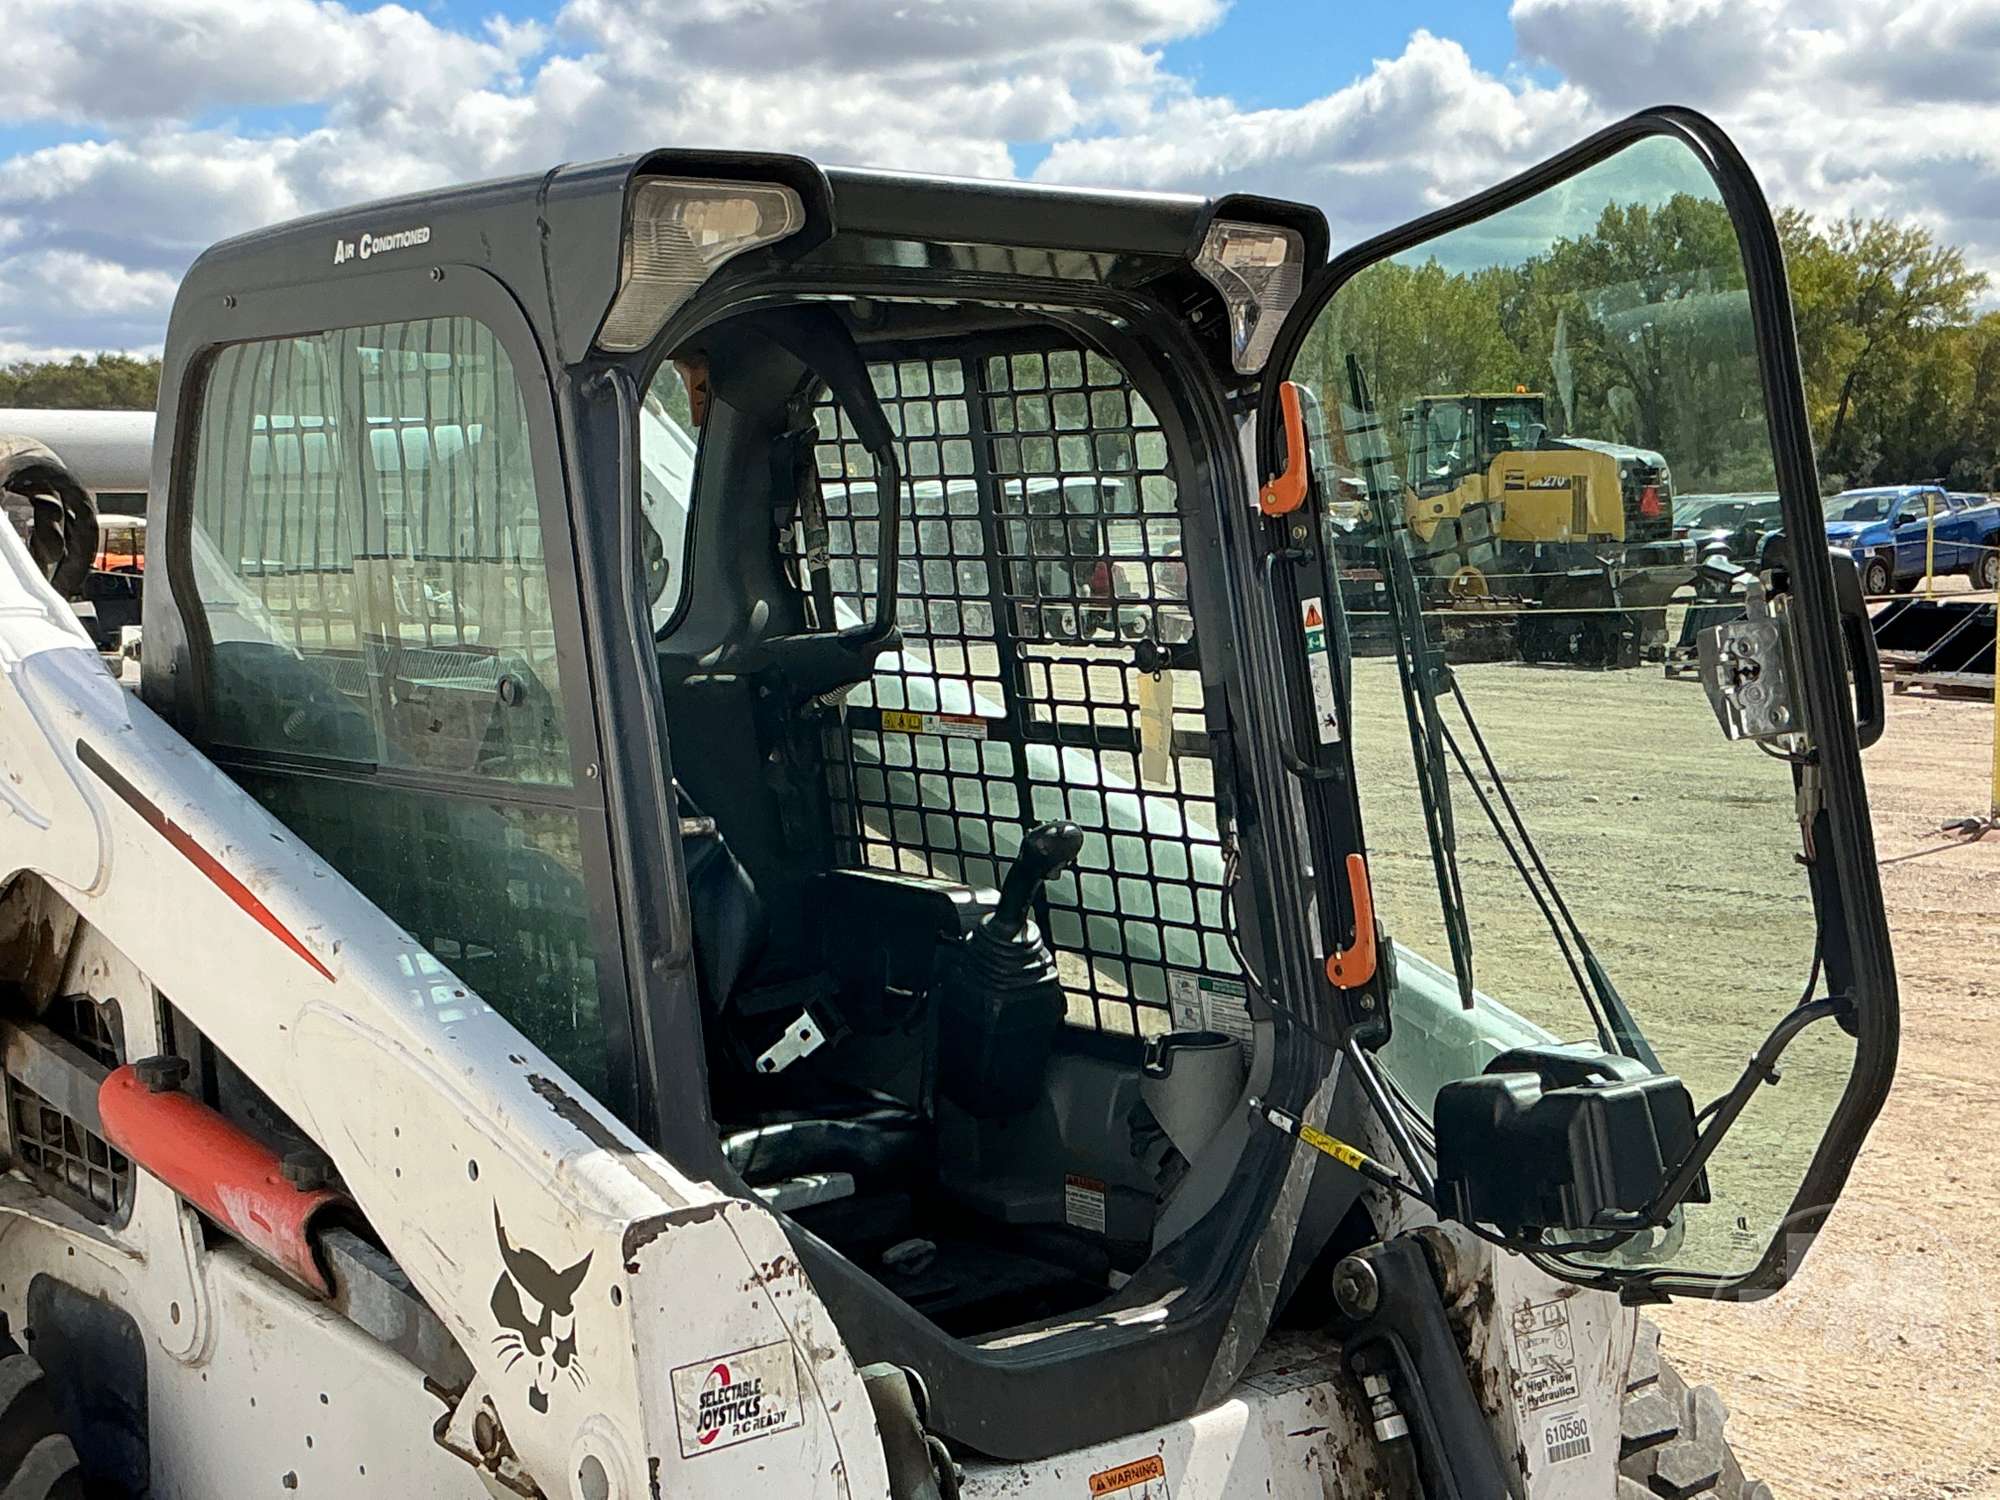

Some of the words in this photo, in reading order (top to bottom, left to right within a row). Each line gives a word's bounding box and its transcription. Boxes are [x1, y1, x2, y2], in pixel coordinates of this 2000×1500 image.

[334, 240, 355, 264] AIR
[360, 227, 430, 259] CONDITIONED
[699, 1377, 762, 1410] SELECTABLE
[1526, 1377, 1548, 1393] High
[1550, 1373, 1572, 1385] Flow
[1527, 1386, 1575, 1406] Hydraulics
[696, 1396, 761, 1433] JOYSTICKS
[753, 1410, 787, 1430] READY
[1545, 1418, 1588, 1446] 610580
[1105, 1461, 1158, 1488] WARNING
